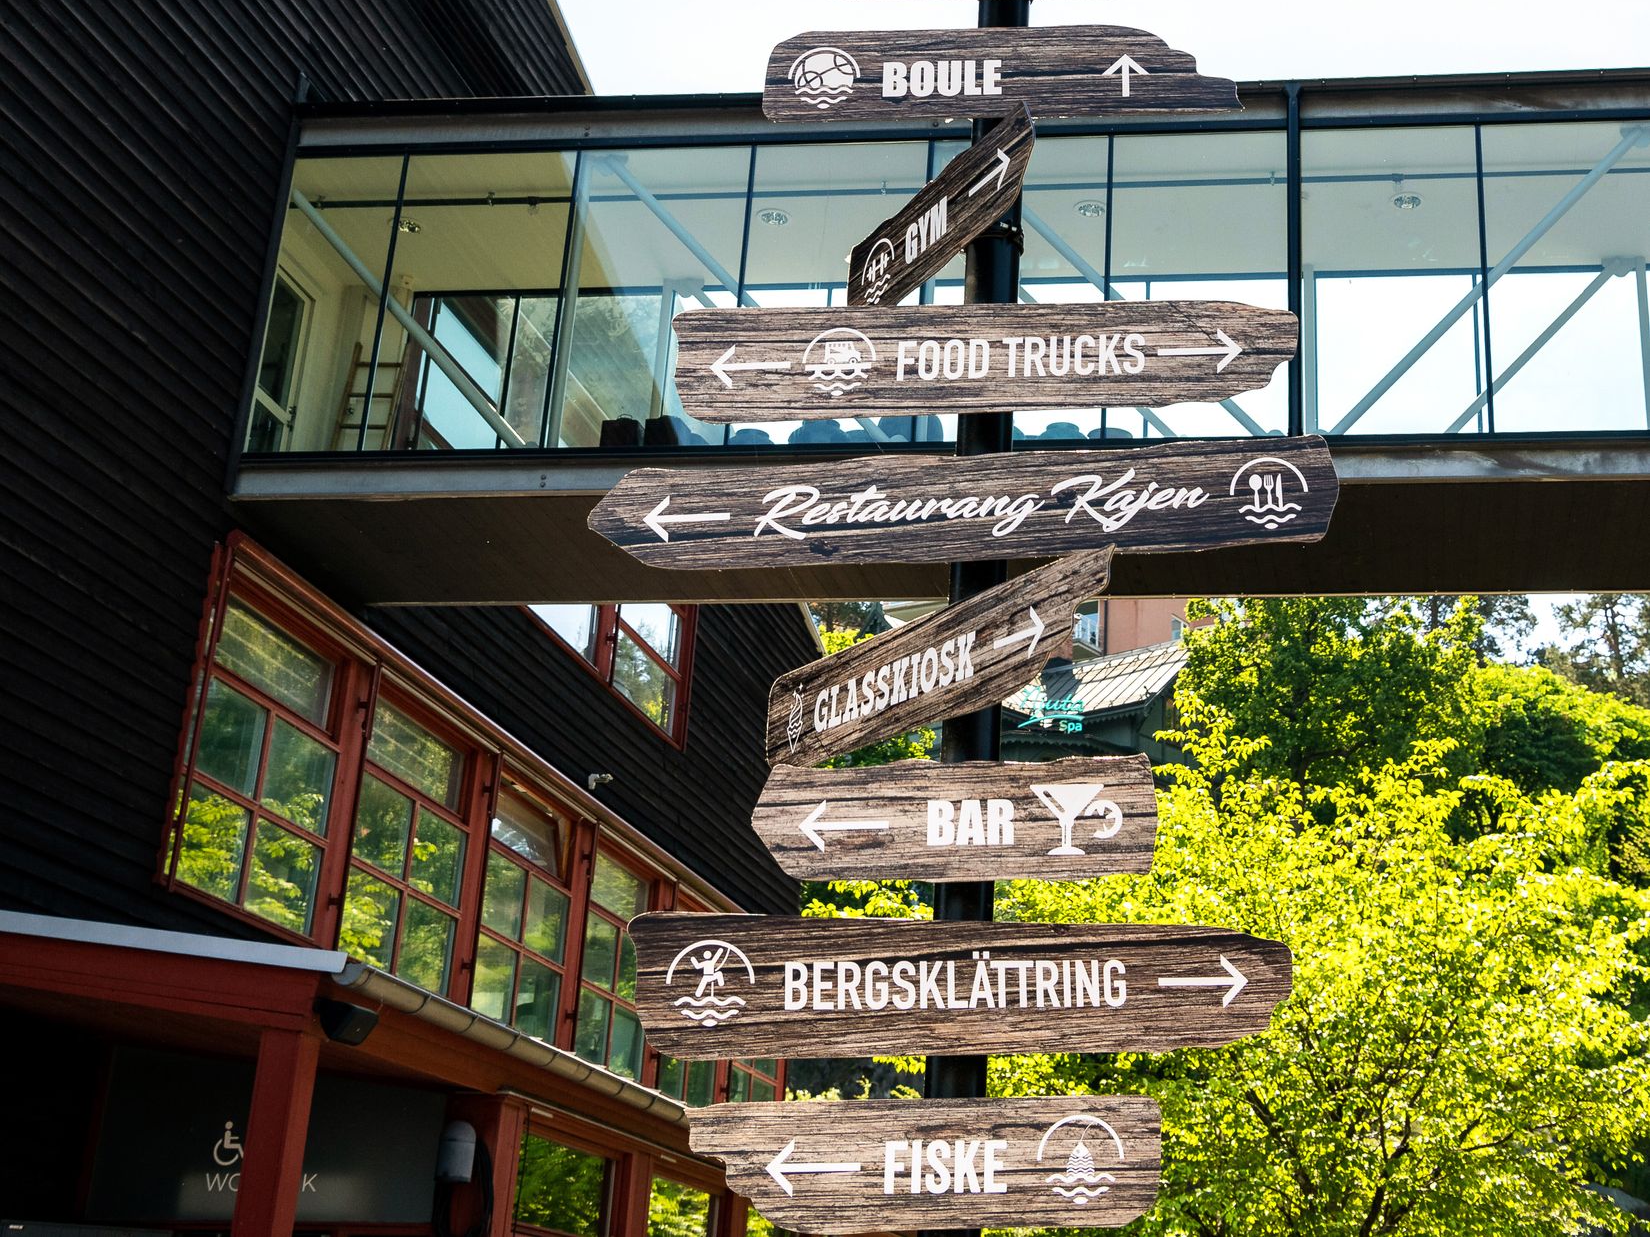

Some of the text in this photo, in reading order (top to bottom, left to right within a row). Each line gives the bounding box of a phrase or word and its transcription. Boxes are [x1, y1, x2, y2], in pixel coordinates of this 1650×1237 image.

[881, 59, 1003, 98] BOULE
[905, 196, 949, 264] GYM
[896, 333, 1147, 382] FOOD TRUCKS
[753, 467, 1210, 540] Restaurang Kajen
[813, 631, 976, 733] GLASSKIOSK
[1058, 719, 1083, 734] Spa
[925, 798, 1015, 847] BAR
[783, 951, 1128, 1011] BERGSKLÄTTRING
[882, 1138, 1009, 1195] FISKE
